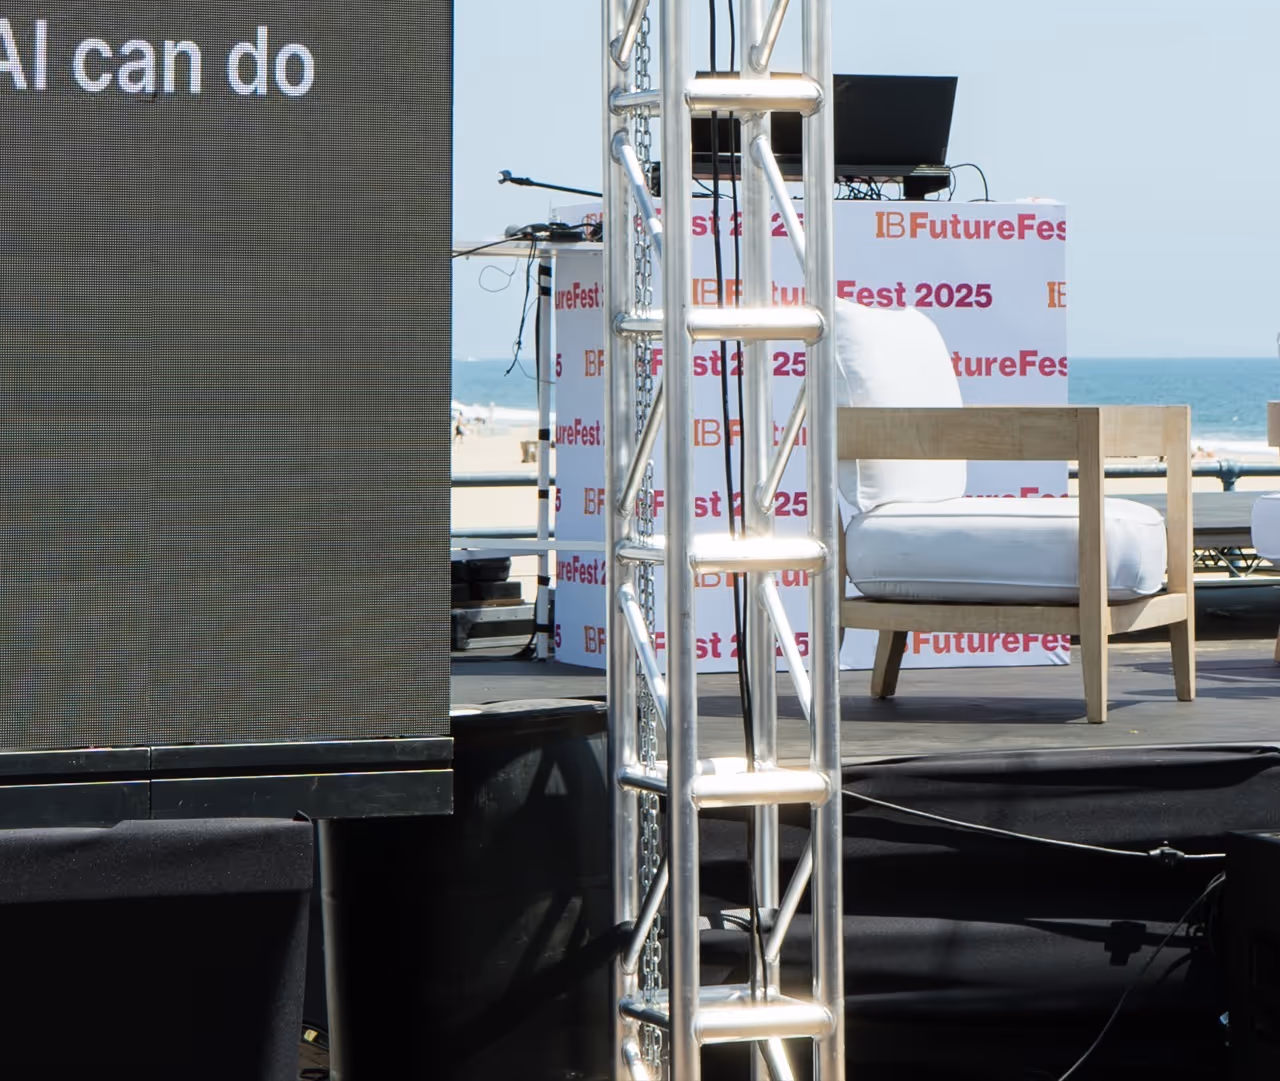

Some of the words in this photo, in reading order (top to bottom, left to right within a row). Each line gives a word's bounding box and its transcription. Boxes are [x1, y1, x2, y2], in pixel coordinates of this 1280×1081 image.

[73, 36, 203, 94] can
[226, 25, 316, 97] do
[914, 282, 993, 309] 2025
